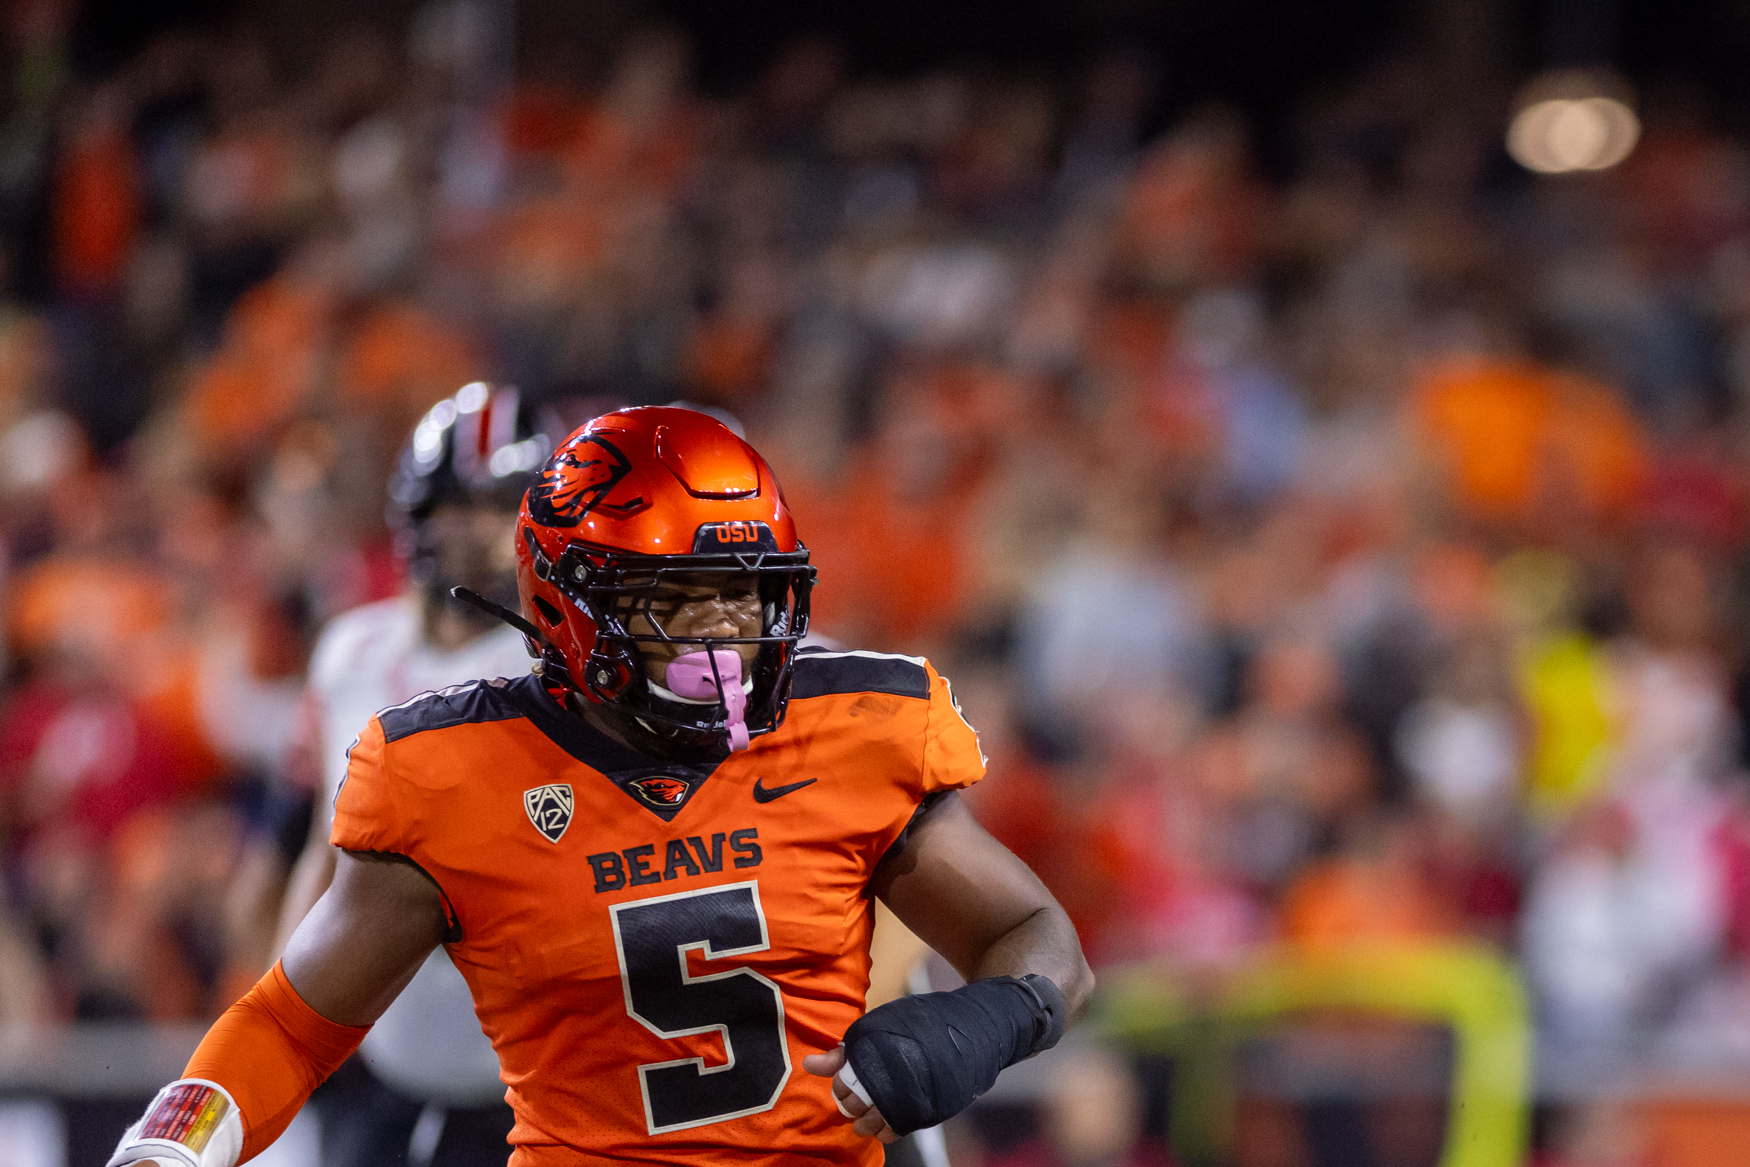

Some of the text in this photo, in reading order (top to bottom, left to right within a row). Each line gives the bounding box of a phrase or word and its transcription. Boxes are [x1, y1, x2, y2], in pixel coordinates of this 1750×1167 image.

[716, 524, 758, 542] OSU
[525, 786, 571, 821] PAC
[540, 808, 565, 831] 12
[586, 828, 763, 894] BEAVS
[608, 879, 792, 1136] 5
